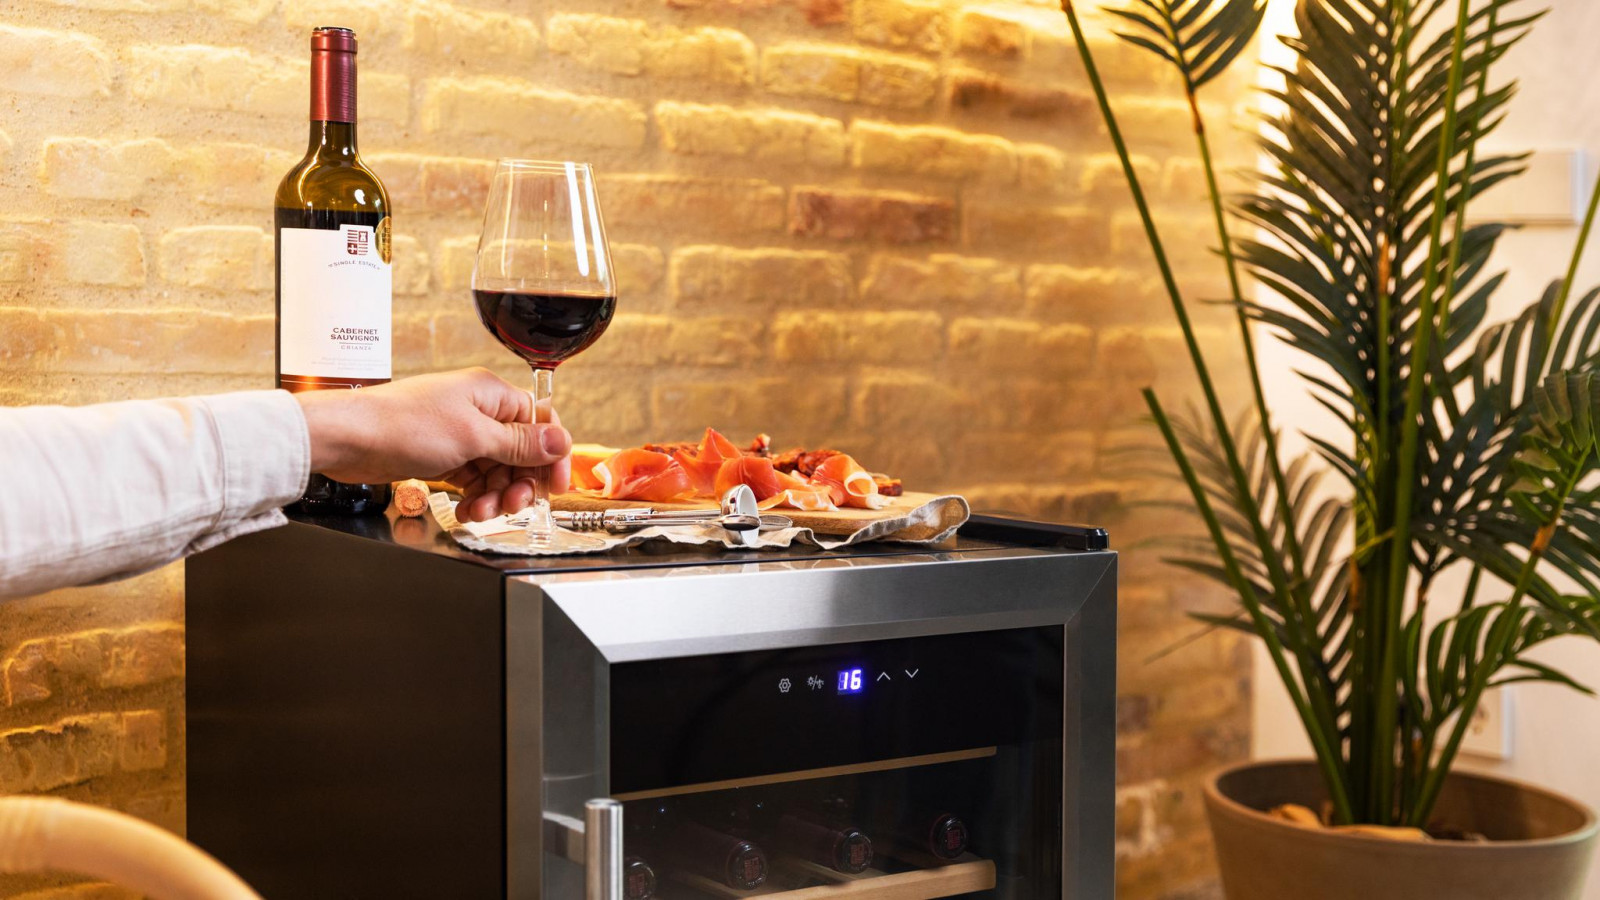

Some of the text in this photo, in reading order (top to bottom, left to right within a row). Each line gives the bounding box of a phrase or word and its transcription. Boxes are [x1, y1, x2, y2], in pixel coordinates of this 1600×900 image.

[358, 260, 377, 269] ESTATE
[332, 327, 378, 335] CABERNET
[330, 334, 380, 342] SAUVIGNON
[842, 669, 862, 690] 16
